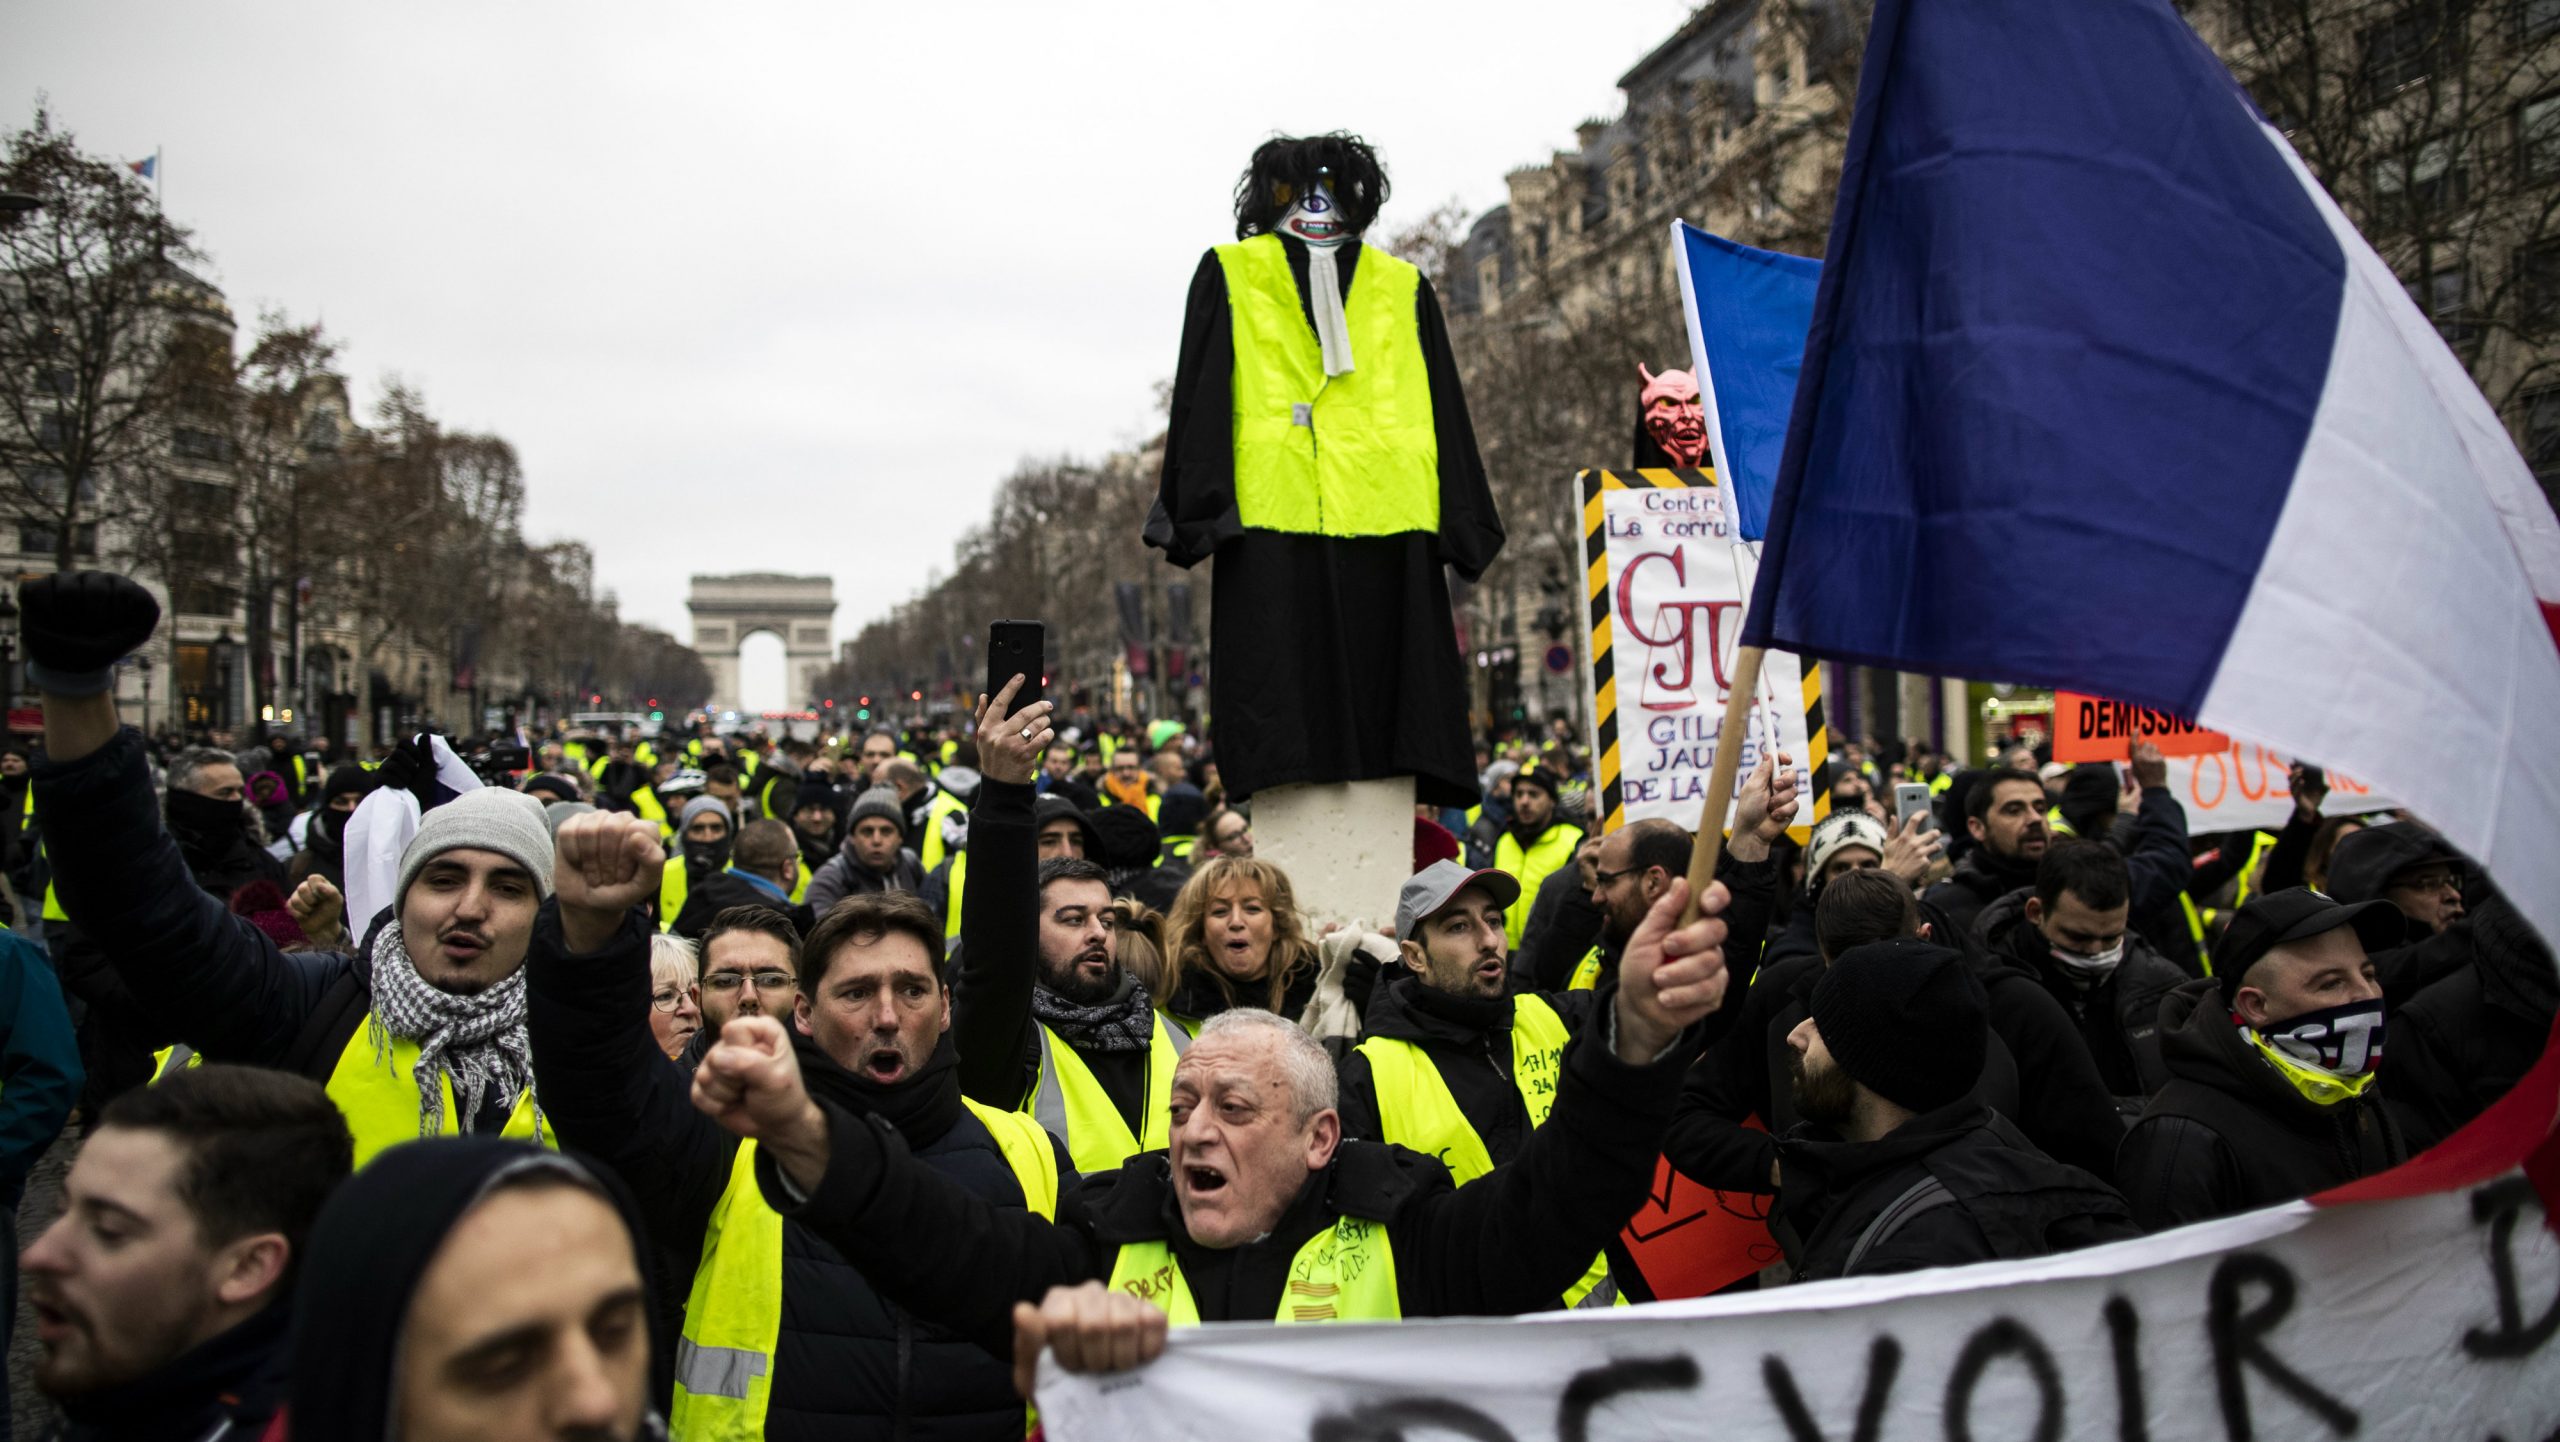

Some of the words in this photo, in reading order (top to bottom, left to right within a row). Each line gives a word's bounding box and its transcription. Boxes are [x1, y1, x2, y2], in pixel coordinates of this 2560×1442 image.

[1608, 513, 1642, 536] La
[1648, 711, 1781, 745] GILTS
[2079, 699, 2214, 739] DEMISSI
[1649, 742, 1780, 772] JAUE
[1623, 777, 1661, 804] DE
[1669, 775, 1705, 802] LA
